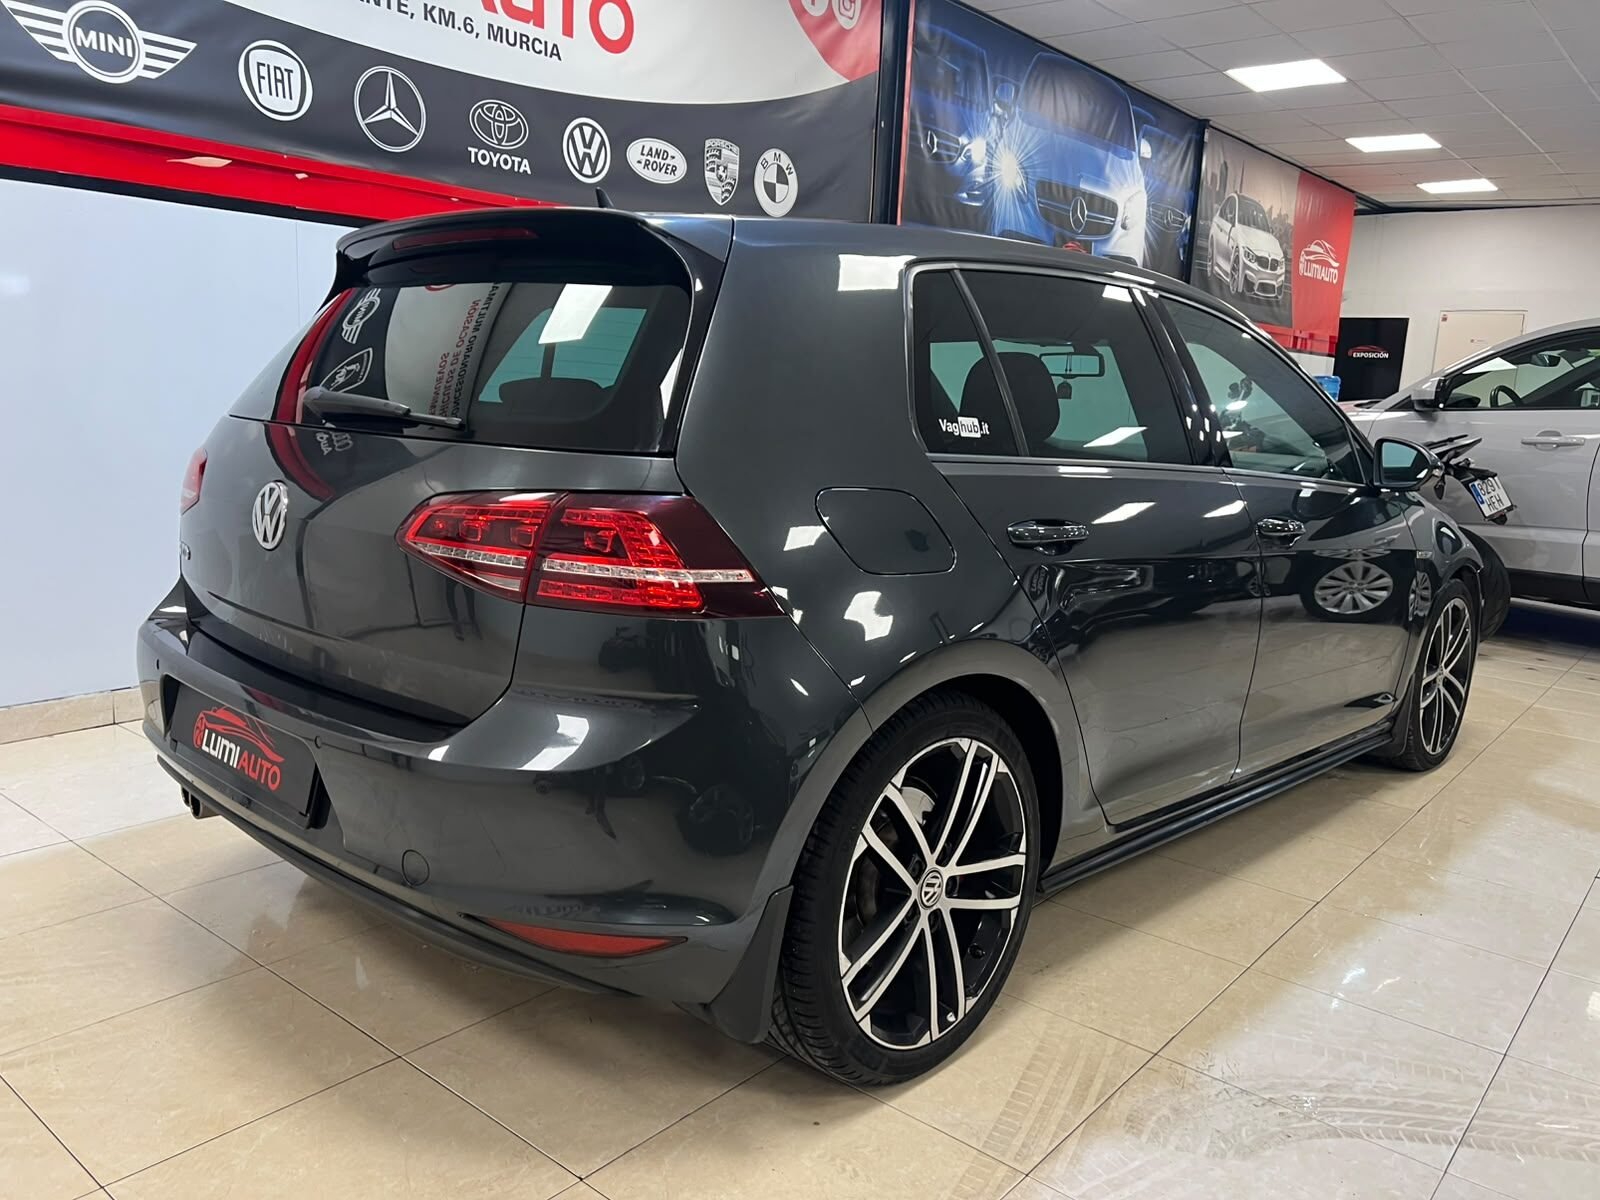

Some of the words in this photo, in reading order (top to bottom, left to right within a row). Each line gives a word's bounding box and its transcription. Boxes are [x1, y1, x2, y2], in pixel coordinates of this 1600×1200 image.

[75, 26, 134, 58] MINI
[423, 2, 480, 38] KM.6,
[487, 22, 562, 61] MURCIA
[256, 62, 295, 101] FIAT
[468, 146, 532, 175] TOYOTA
[640, 144, 669, 160] LAND
[643, 157, 678, 177] ROVER
[1352, 351, 1389, 359] EXPOSICIÓN
[201, 729, 281, 791] LUMIAUTO
